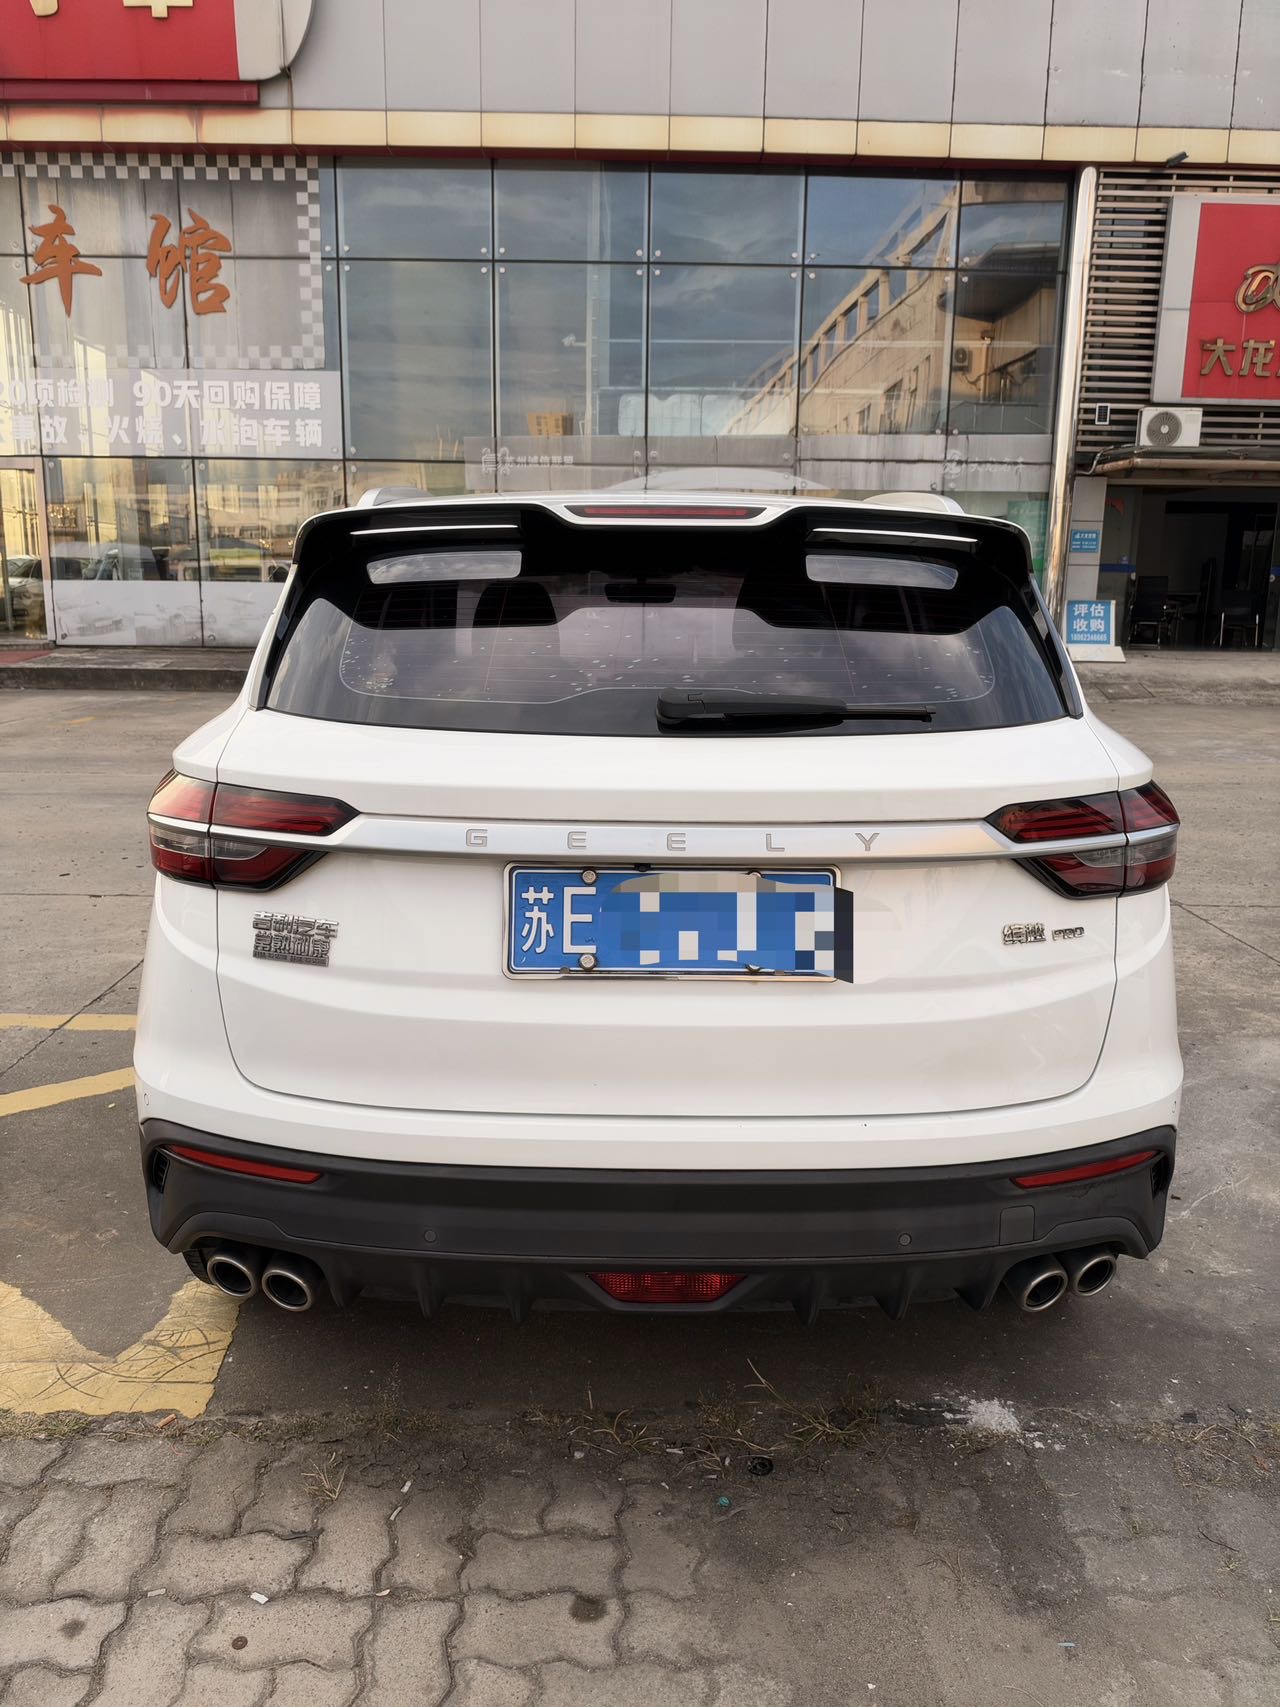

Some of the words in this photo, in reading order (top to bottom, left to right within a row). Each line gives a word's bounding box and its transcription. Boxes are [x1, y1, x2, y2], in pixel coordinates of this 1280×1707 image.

[20, 204, 232, 318] 车馆
[1200, 337, 1280, 378] 大龙
[0, 379, 114, 408] 0项检测
[133, 380, 322, 410] 90天回购保障
[0, 412, 323, 447] 事故、火烧、水泡车辆
[1073, 603, 1105, 617] 评估
[1073, 618, 1105, 632] 收购
[465, 828, 880, 852] GEELY
[252, 911, 339, 940] 吉利汽车
[1052, 926, 1085, 942] PRO
